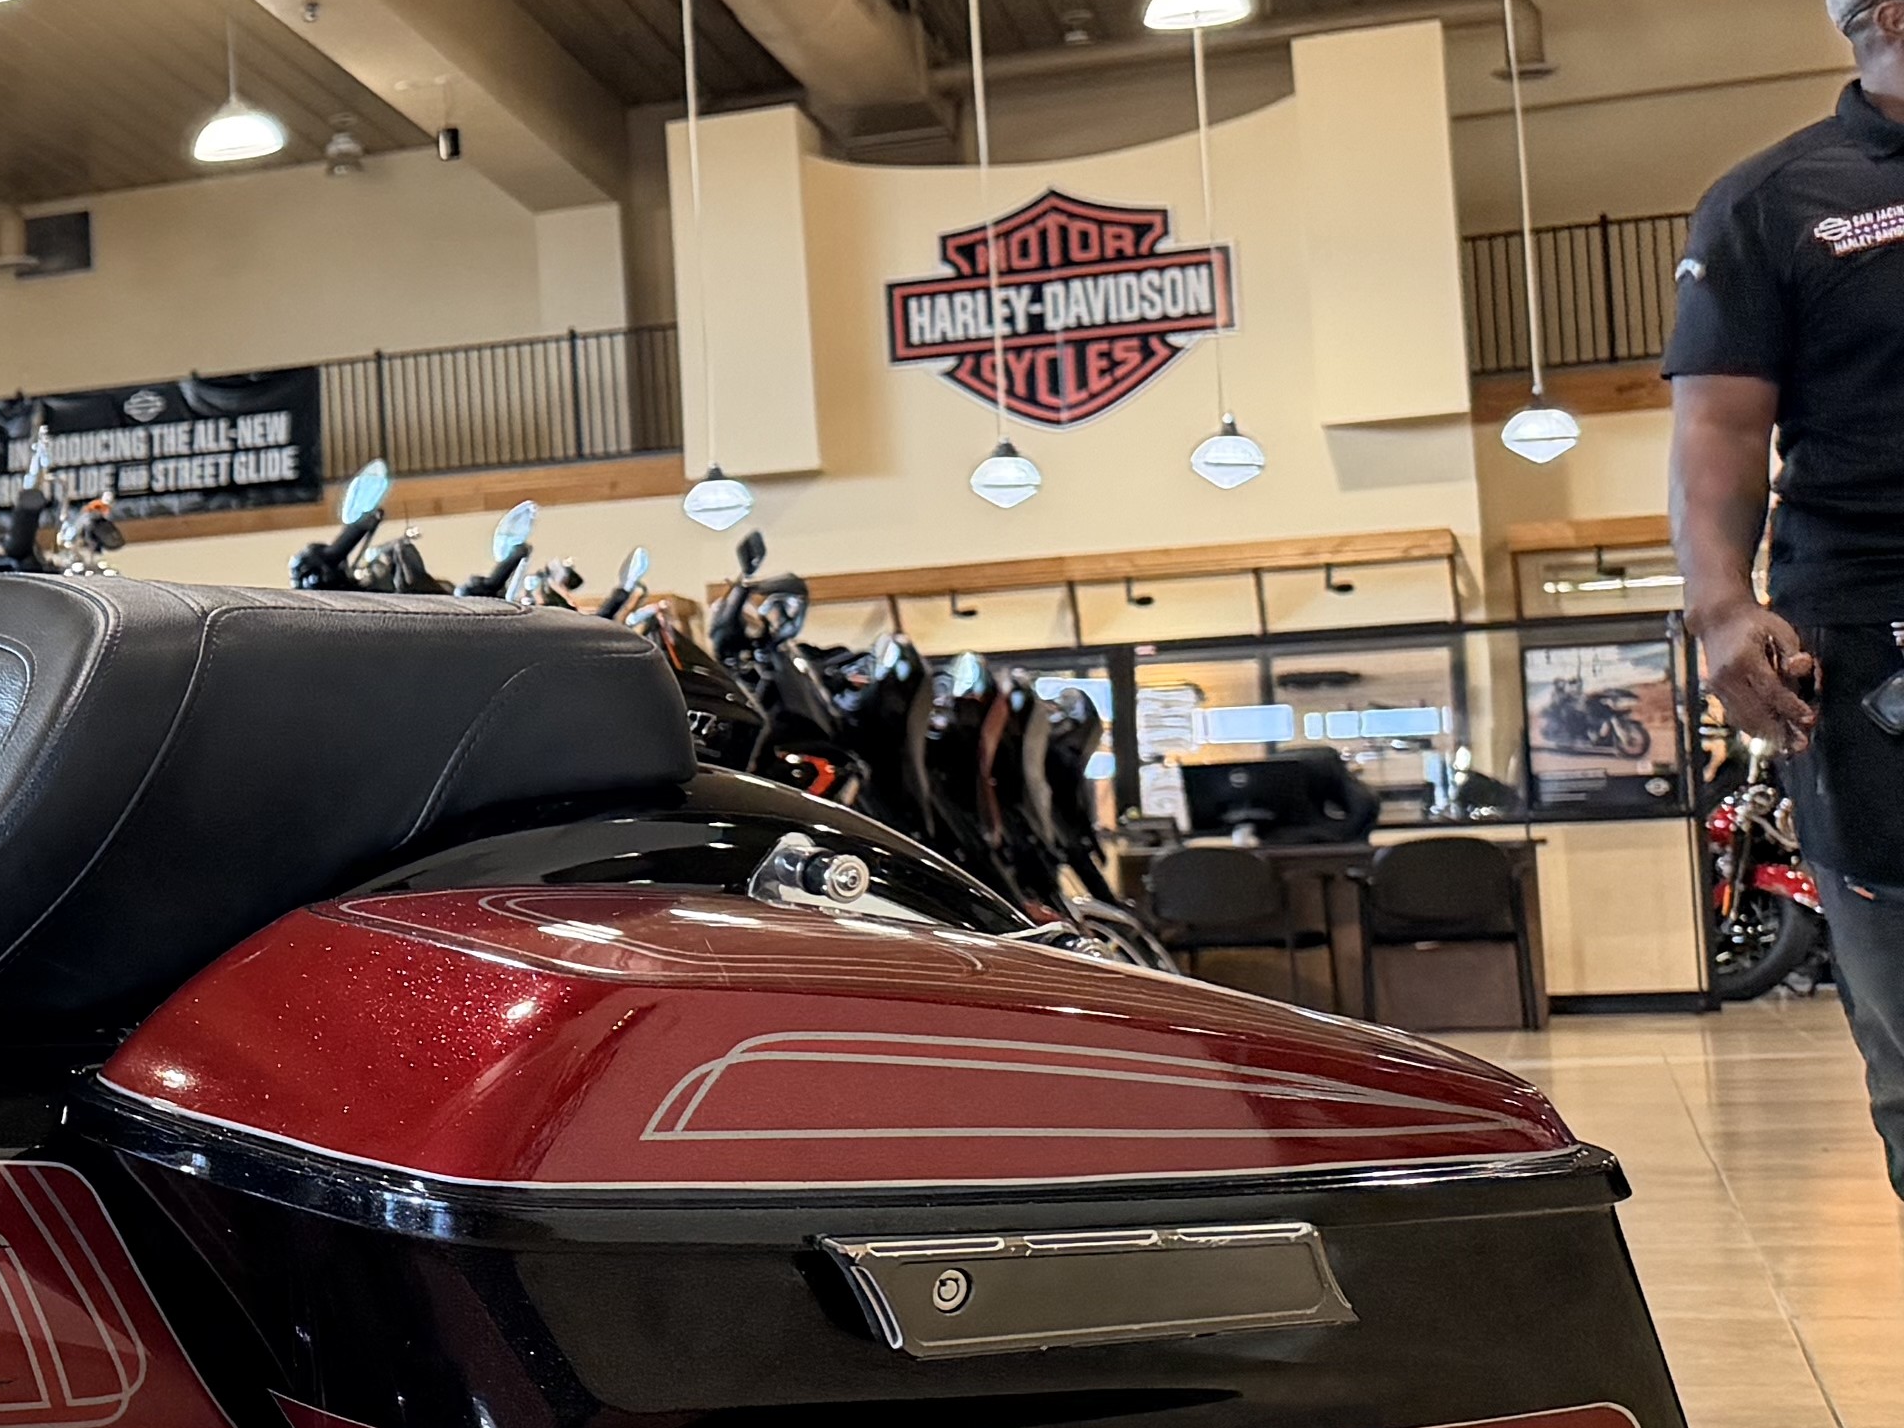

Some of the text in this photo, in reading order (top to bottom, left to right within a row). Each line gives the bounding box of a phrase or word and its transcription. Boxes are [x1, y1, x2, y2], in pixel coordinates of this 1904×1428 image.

[1852, 204, 1904, 227] SAN JACIN
[975, 213, 1137, 274] MOTOR
[906, 264, 1212, 345] HARLEY-DAVIDSON
[980, 335, 1143, 408] CYCLES
[150, 423, 191, 457] THE
[193, 411, 291, 453] ALL-NEW
[150, 453, 232, 493] STREET
[232, 445, 299, 485] GLIDE
